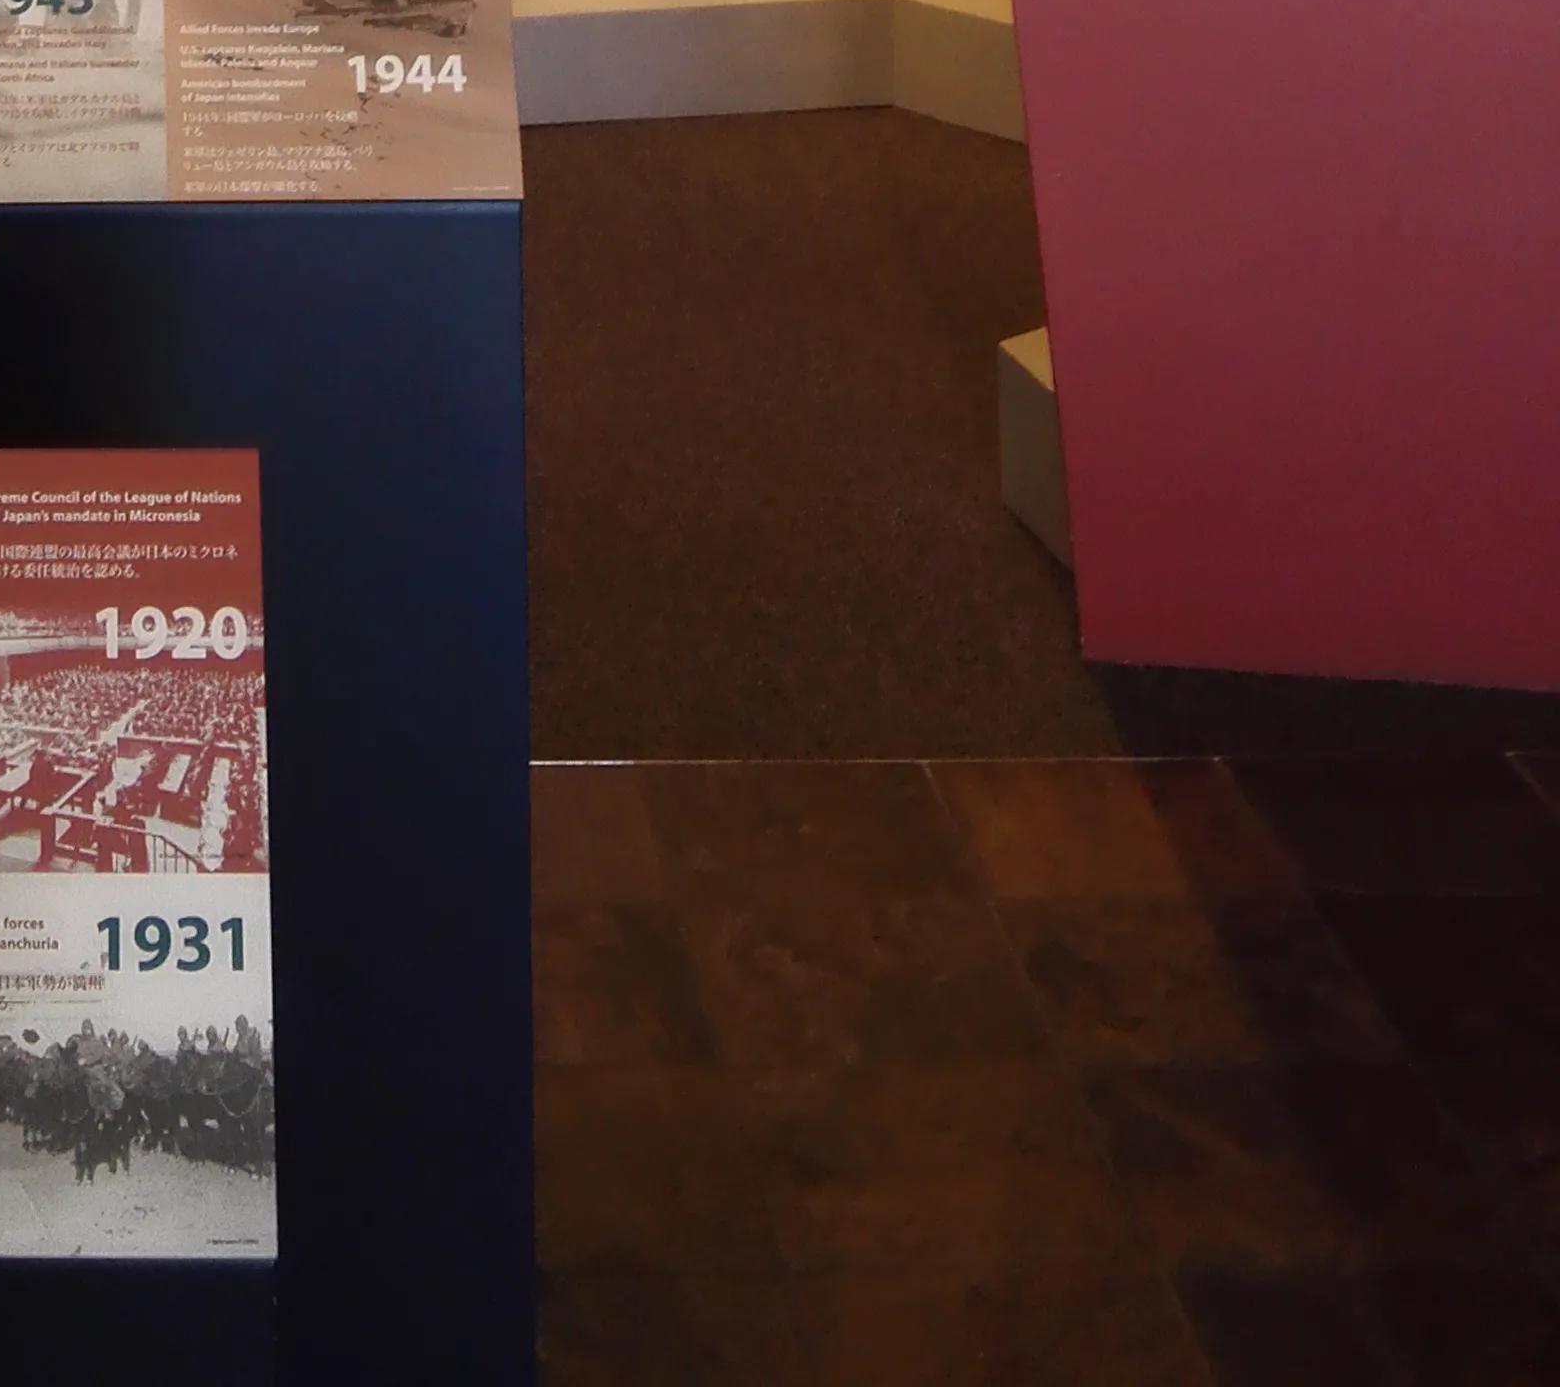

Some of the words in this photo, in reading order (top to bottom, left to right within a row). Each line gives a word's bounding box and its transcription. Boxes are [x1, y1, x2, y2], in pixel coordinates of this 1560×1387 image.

[347, 55, 467, 95] 1944
[31, 490, 80, 504] Council
[82, 490, 97, 504] of
[99, 490, 122, 504] the
[124, 491, 172, 507] League
[174, 490, 189, 504] of
[190, 490, 242, 504] Nations
[2, 509, 50, 524] Japan's
[52, 509, 111, 522] mandate
[113, 508, 127, 522] in
[129, 509, 201, 522] Micronesia
[94, 606, 246, 660] 1920
[3, 916, 45, 930] forces
[97, 916, 244, 972] 1931
